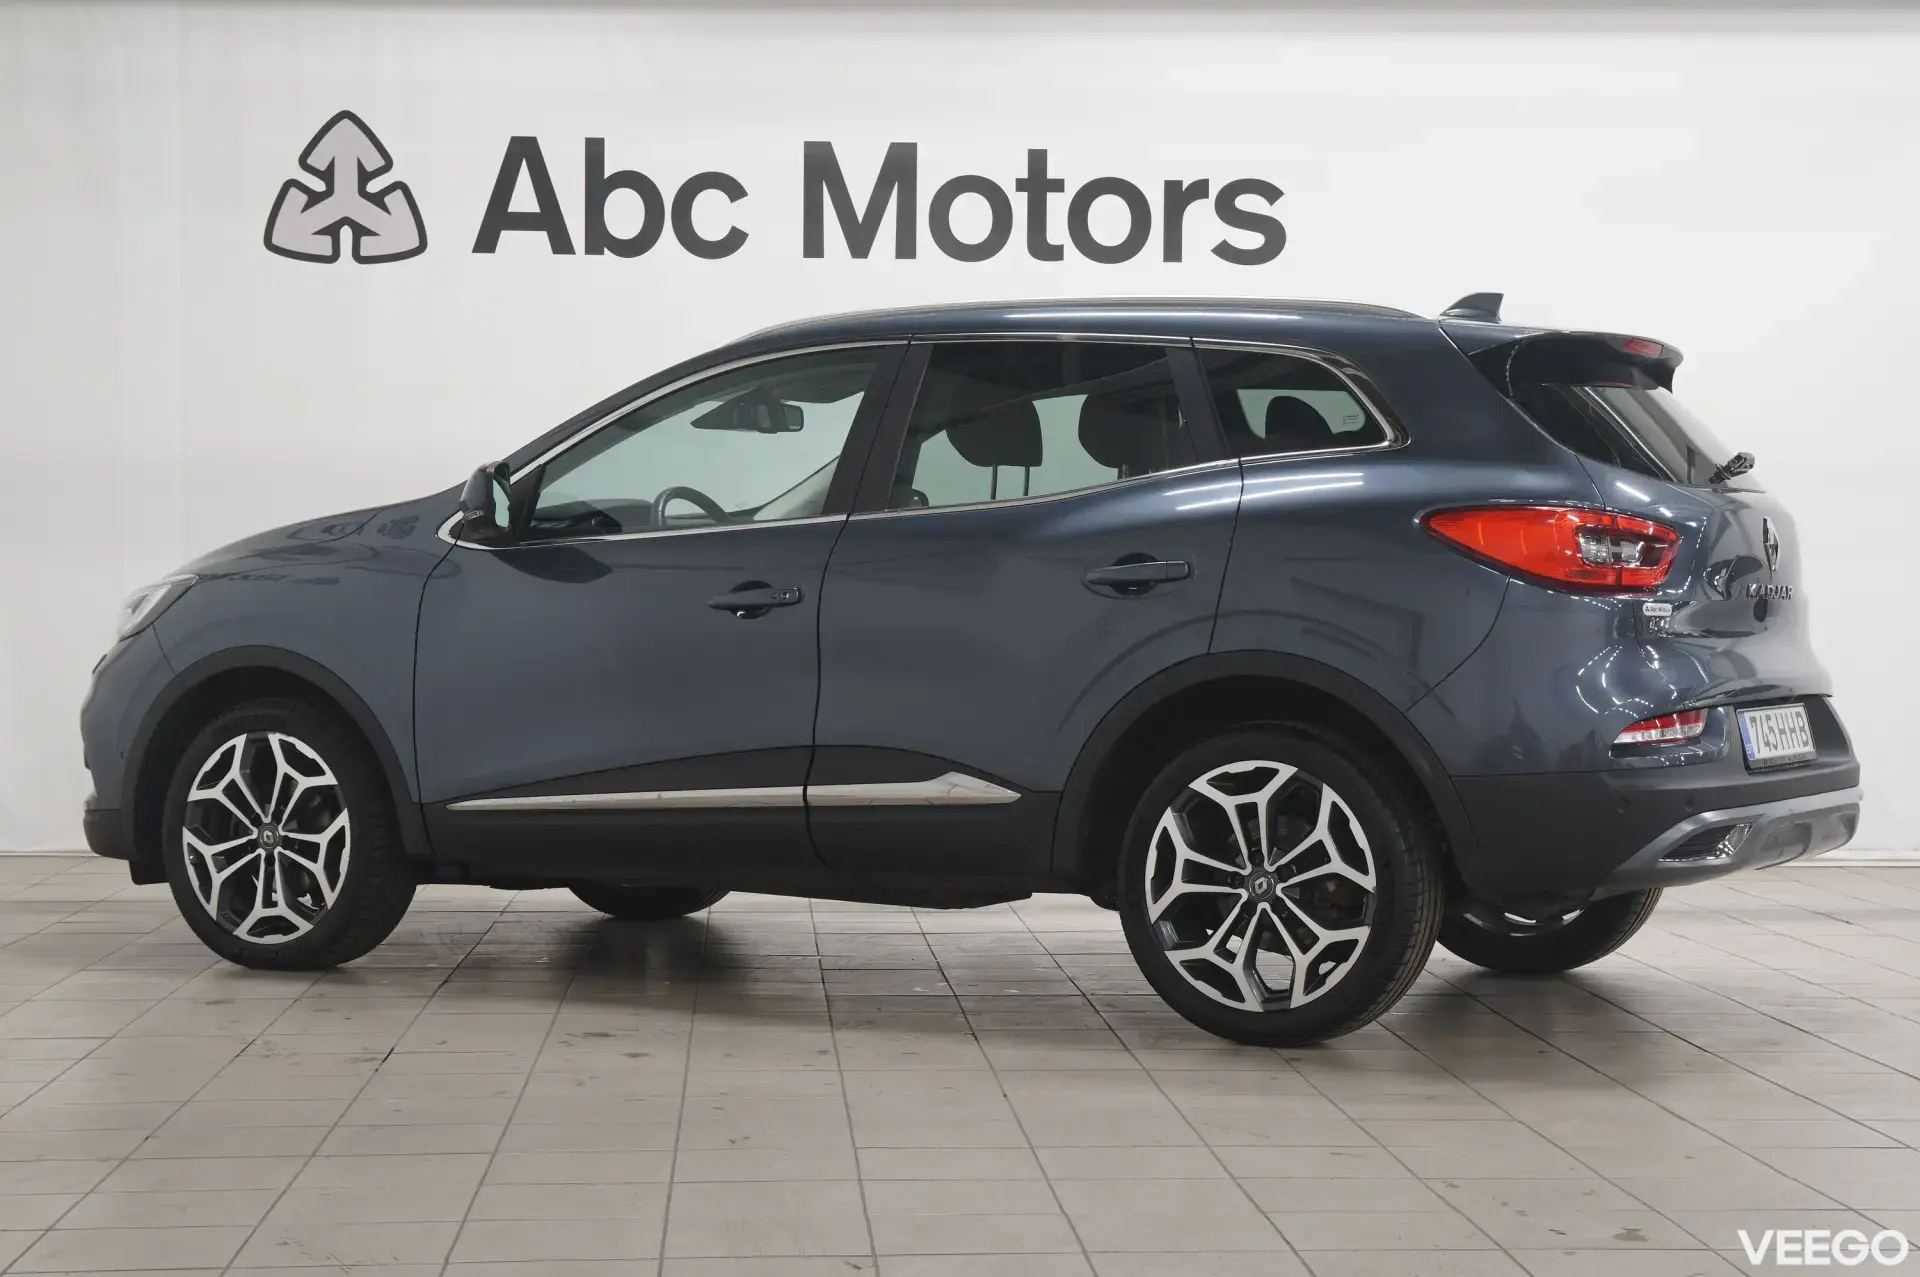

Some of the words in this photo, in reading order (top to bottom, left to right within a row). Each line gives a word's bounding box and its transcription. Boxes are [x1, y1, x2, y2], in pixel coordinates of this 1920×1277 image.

[472, 136, 749, 260] Abc
[803, 141, 1287, 266] Motors
[1746, 584, 1794, 600] KADJAR
